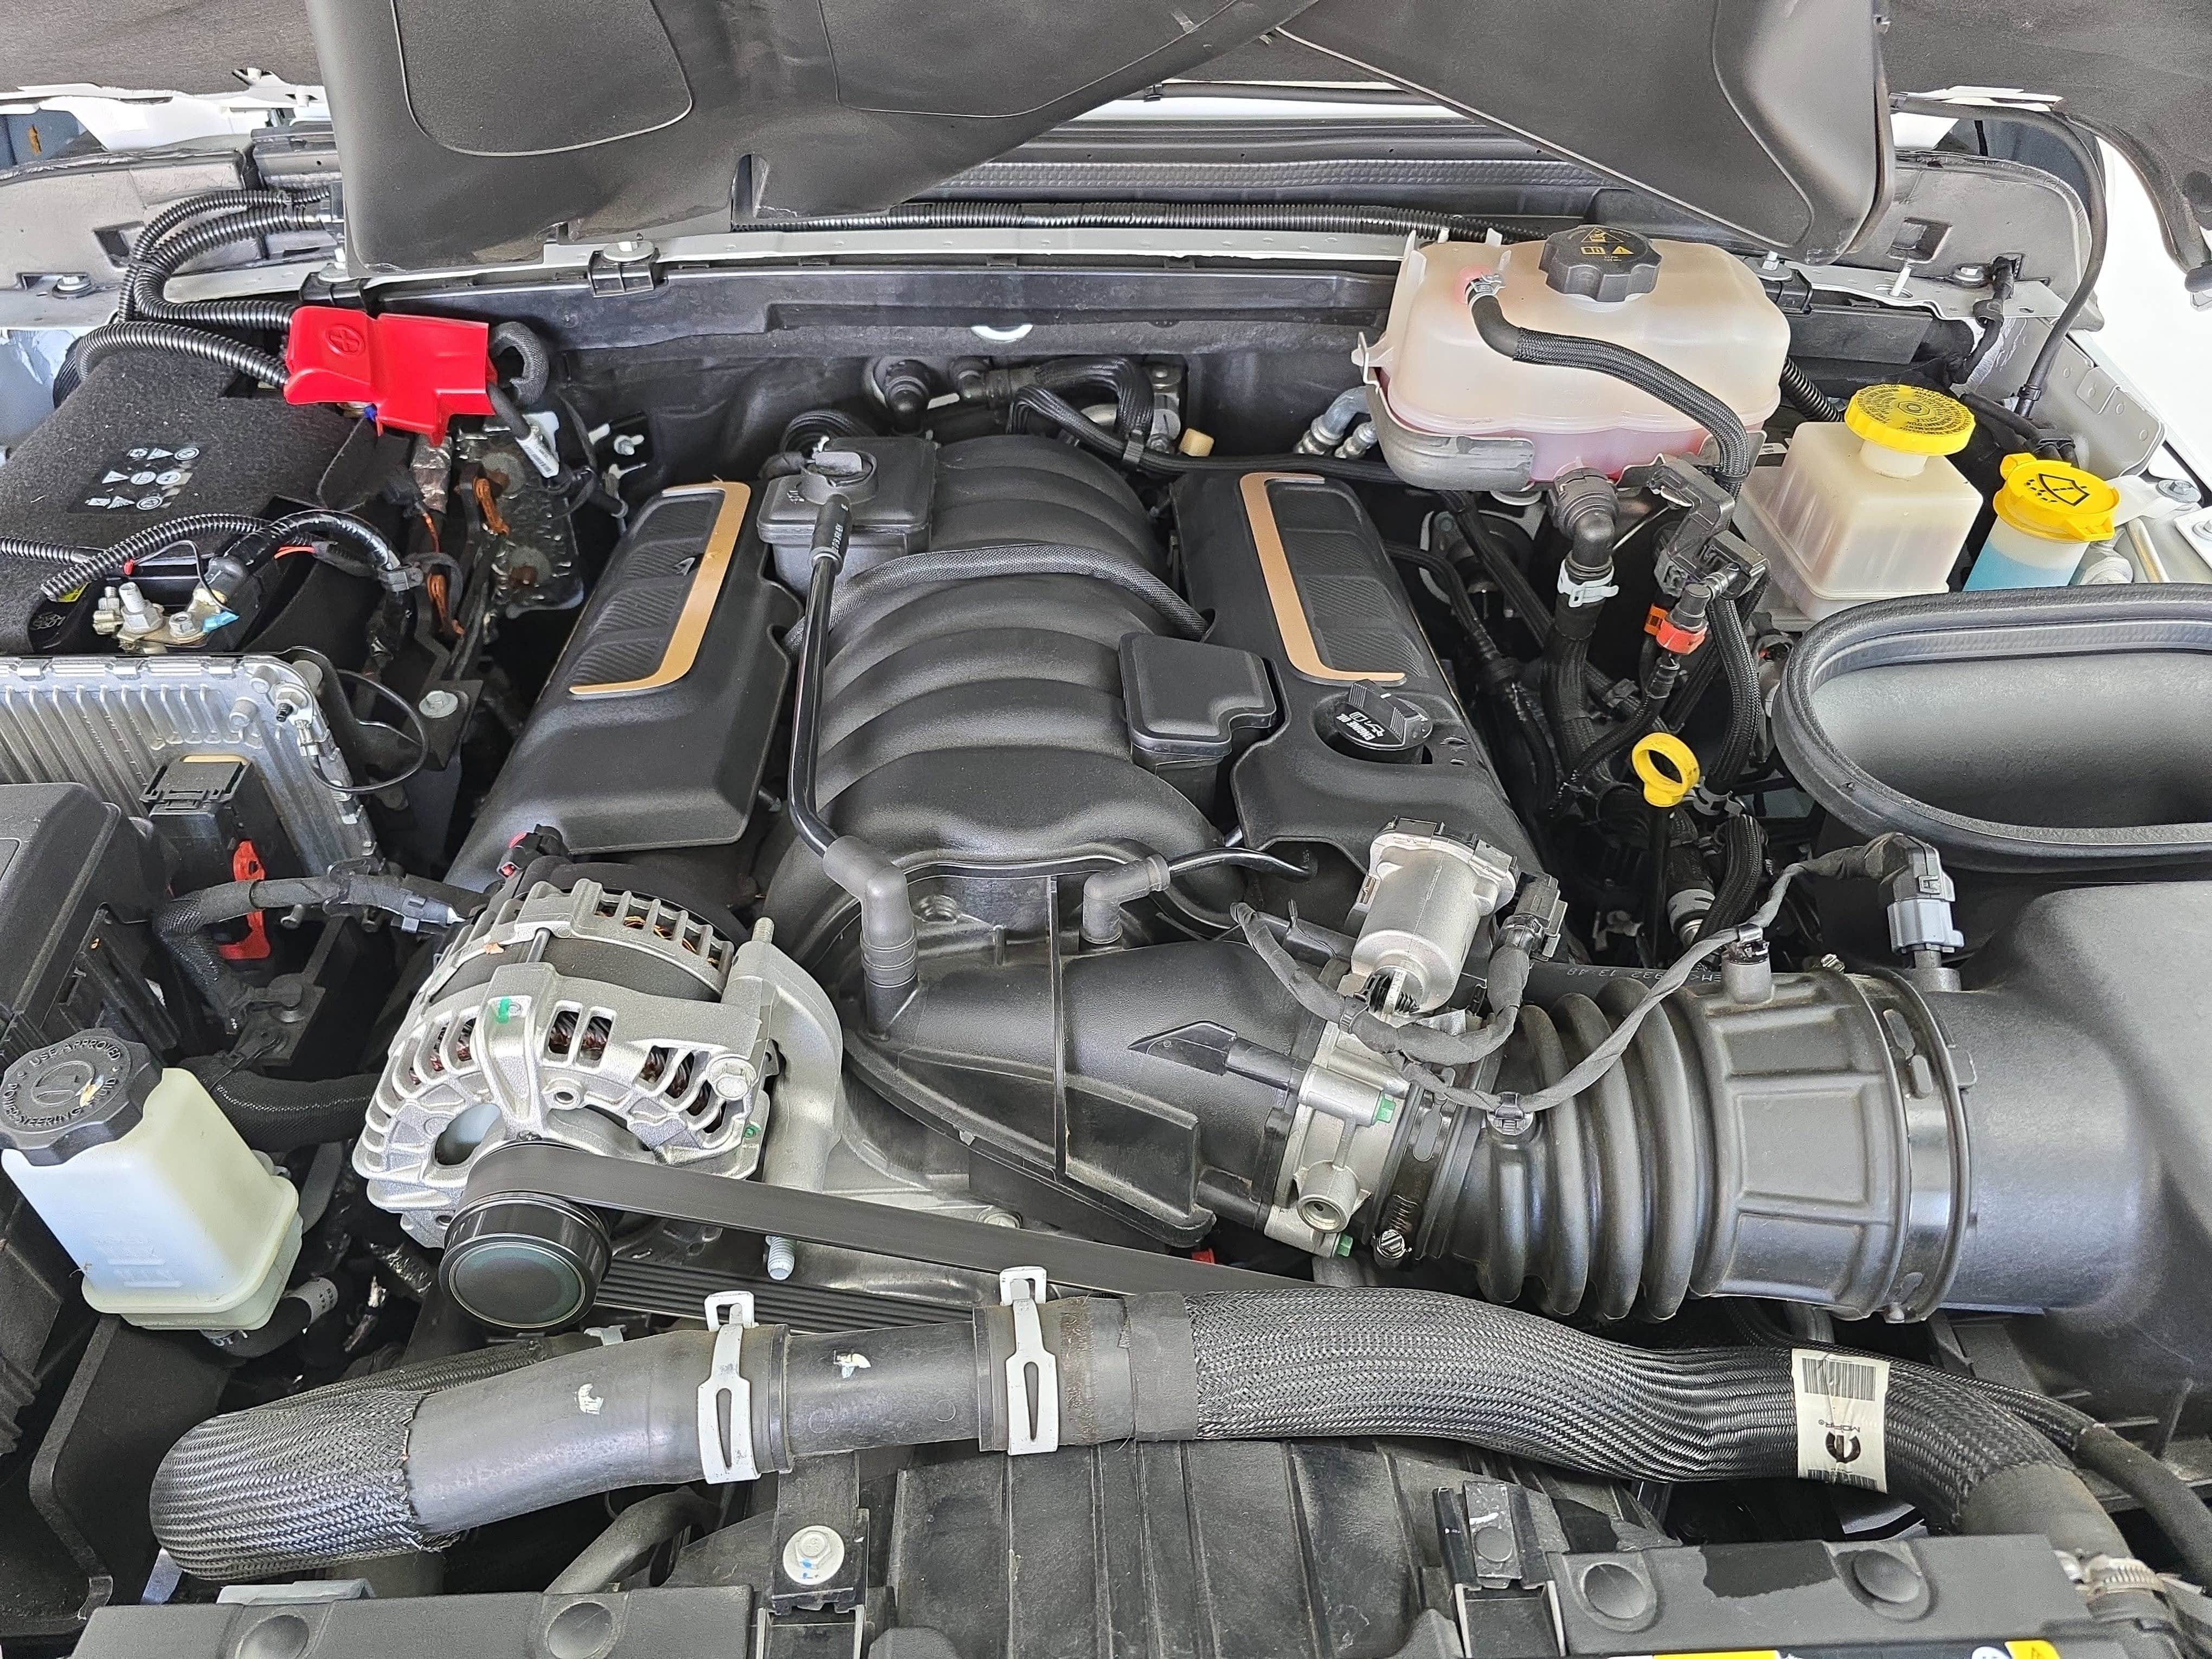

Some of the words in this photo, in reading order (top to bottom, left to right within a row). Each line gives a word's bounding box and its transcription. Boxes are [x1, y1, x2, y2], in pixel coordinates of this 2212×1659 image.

[1336, 713, 1352, 723] OIL
[1346, 721, 1375, 741] ENGINE
[29, 1048, 57, 1067] USE
[62, 1039, 122, 1061] APPROVED
[2, 1083, 21, 1120] POWER
[16, 1106, 83, 1126] STEERING
